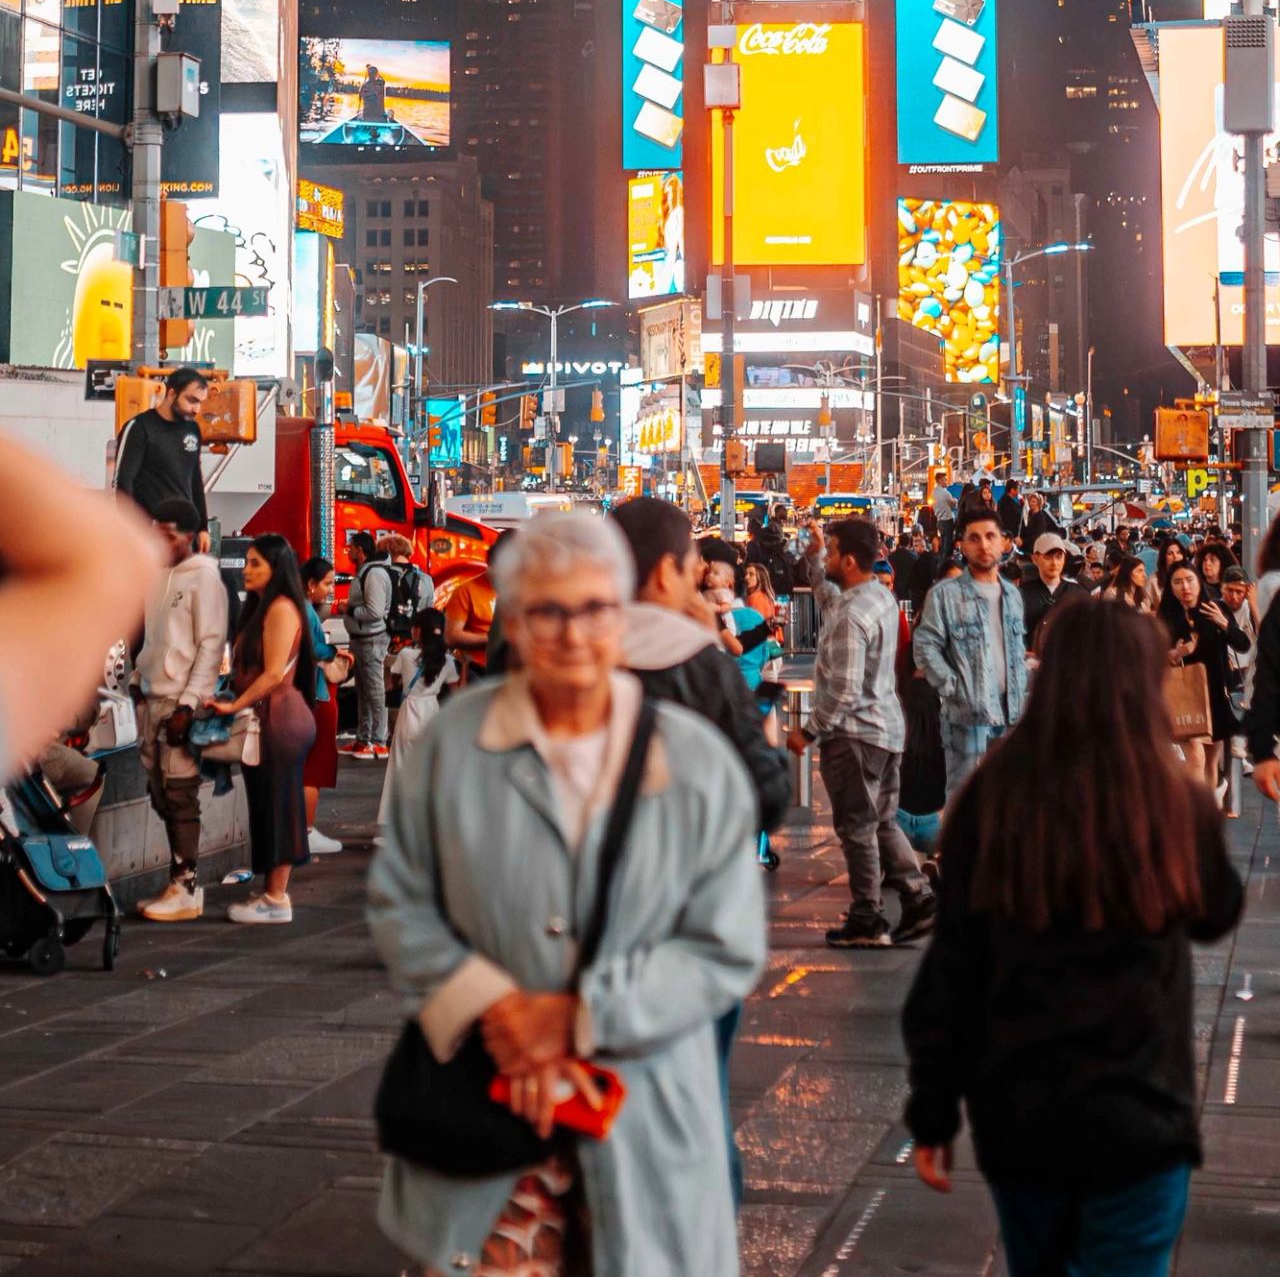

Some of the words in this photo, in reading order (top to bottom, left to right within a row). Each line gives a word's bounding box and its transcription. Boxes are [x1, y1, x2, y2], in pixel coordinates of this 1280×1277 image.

[189, 292, 207, 315] W
[216, 292, 243, 315] 44
[252, 292, 267, 306] St
[1241, 399, 1265, 408] Square
